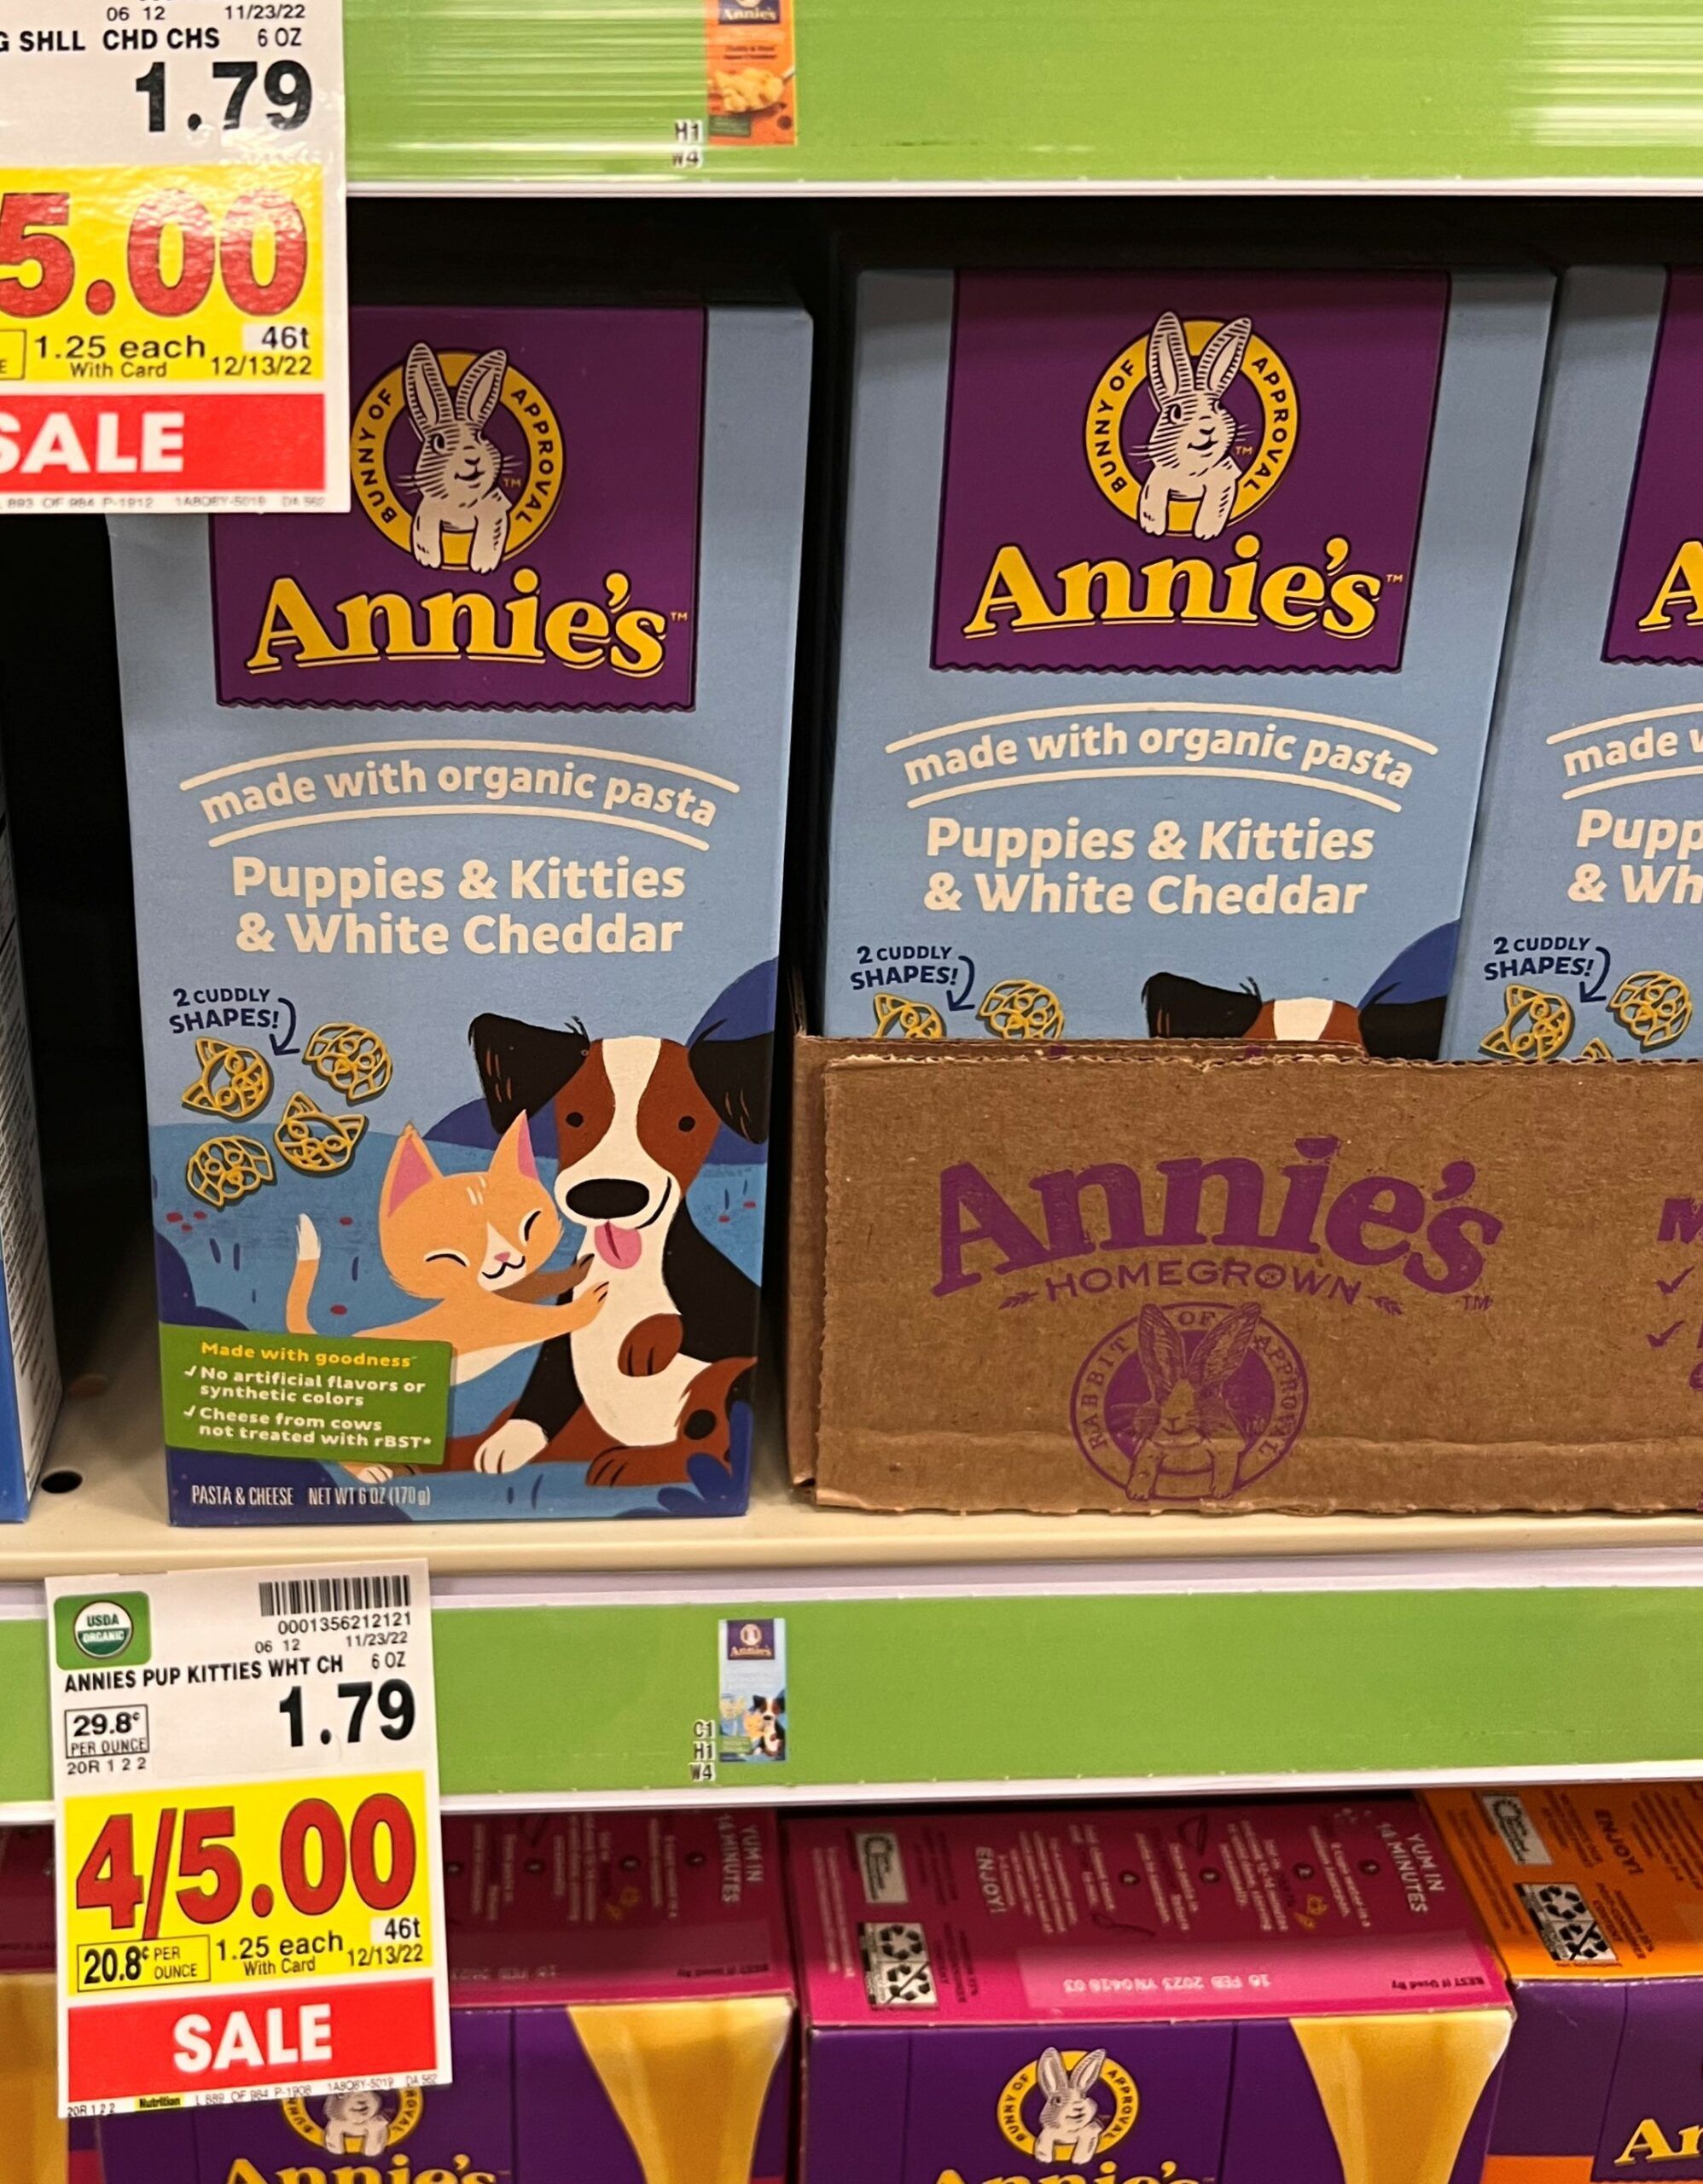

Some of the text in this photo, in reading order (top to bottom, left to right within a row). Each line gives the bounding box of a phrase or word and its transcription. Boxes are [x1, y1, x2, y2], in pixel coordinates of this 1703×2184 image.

[107, 4, 305, 21] 06 12 11/23/22
[20, 31, 85, 52] SHLL
[102, 30, 158, 50] CHD
[166, 28, 219, 49] CHS
[258, 30, 268, 47] 6
[275, 28, 302, 47] OZ
[136, 60, 312, 132] 1.79
[35, 326, 311, 359] 1.25 each 46t
[71, 357, 312, 378] With Card 12/13/22
[1095, 356, 1287, 493] BUNNY OF APPROVAL
[0, 413, 184, 473] SALE
[357, 388, 555, 523] BUNNY OF APPROVAL
[962, 534, 1381, 641] Annie's
[245, 568, 666, 678] Annie's
[904, 722, 1413, 790] made with organic pasta
[1563, 727, 1678, 776] made
[201, 760, 717, 828] made with organic pasta
[926, 816, 1375, 869] Puppies & Kitties
[232, 856, 685, 908] Puppies & Kitties
[923, 872, 1368, 916] & White Cheddar
[1567, 863, 1607, 903] &
[235, 911, 683, 955] & White Cheddar
[1493, 937, 1591, 955] 2 CUDDLY
[857, 944, 953, 964] 2 CUDDLY
[1483, 957, 1595, 981] SHAPES!
[850, 964, 959, 990] SHAPES!
[173, 988, 270, 1007] 2 CUDDLY
[169, 1008, 279, 1034] SHAPES!
[932, 1134, 1504, 1298] Annie's
[1044, 1258, 1363, 1305] HOMEGROWN
[201, 1342, 411, 1368] Made with goodness
[200, 1384, 364, 1406] synthetic colors
[201, 1367, 427, 1393] No artificial flavors or
[1081, 1337, 1129, 1450] RABBIT
[1177, 1310, 1217, 1326] OF
[199, 1425, 234, 1438] not
[240, 1426, 316, 1444] treated
[321, 1432, 369, 1448] with
[200, 1408, 382, 1432] Cheese from cows
[191, 1484, 232, 1505] PASTA
[235, 1486, 246, 1505] &
[248, 1487, 294, 1506] CHEESE
[308, 1487, 331, 1506] NET
[334, 1487, 355, 1506] WT
[370, 1487, 387, 1505] OZ
[81, 1629, 125, 1644] ORGANIC
[86, 1613, 119, 1629] USDA
[277, 1612, 412, 1635] 0001356212121
[254, 1631, 409, 1653] 06 12 11/23/22
[64, 1651, 406, 1693] ANNIES PUP KITTIES WHT CH 6 OZ
[279, 1677, 416, 1748] 1.79
[71, 1737, 148, 1756] PER OUNCE
[67, 1757, 147, 1775] 20R 1 2 2
[76, 1792, 417, 1941] 4/5.00
[721, 1834, 741, 1902] MINUTES
[745, 1864, 764, 1882] IN
[1387, 1841, 1428, 1912] MINUTES
[1405, 1833, 1445, 1891] YUM IN
[154, 1947, 181, 1960] PER
[216, 1918, 421, 1961] 1.25 each 46t
[154, 1962, 198, 1980] OUNCE
[242, 1943, 424, 1977] With Card 12/13/22
[172, 2003, 333, 2073] SALE
[139, 2096, 181, 2109] Nutrition
[1004, 2070, 1133, 2142] BUNNY OF APPROVAL
